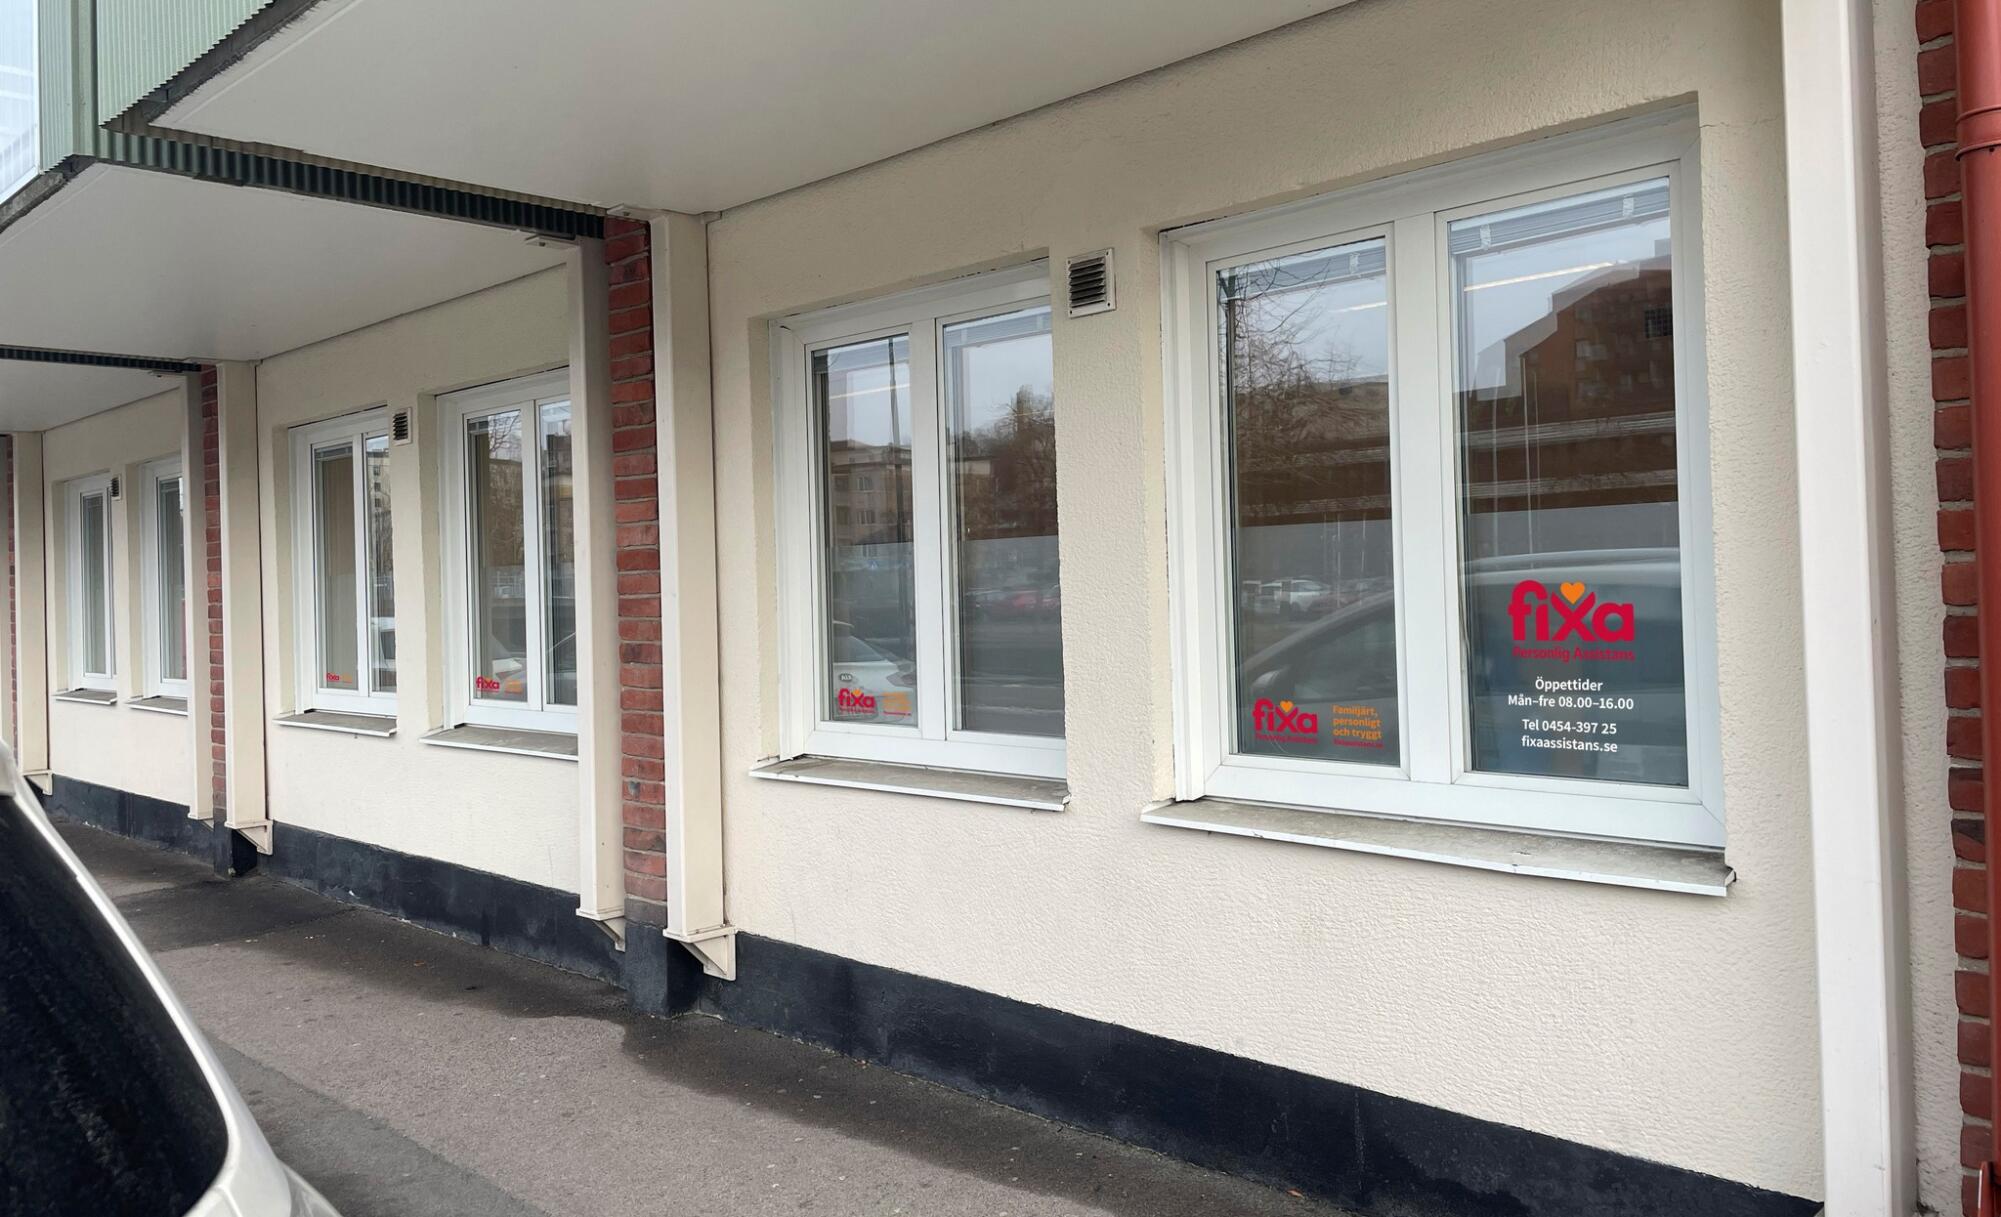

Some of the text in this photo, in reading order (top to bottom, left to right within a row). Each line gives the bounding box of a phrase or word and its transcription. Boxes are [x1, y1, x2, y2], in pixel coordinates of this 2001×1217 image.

[1507, 580, 1635, 643] fixa
[475, 676, 500, 690] fixa
[1535, 676, 1603, 692] Öppettider
[838, 688, 876, 708] fixa
[1252, 697, 1319, 734] fixa
[1332, 717, 1381, 729] personligt
[1332, 728, 1382, 740] och tryggt
[1522, 719, 1617, 734] Tel 0454-397 25
[1521, 735, 1618, 752] fixaassistans.se
